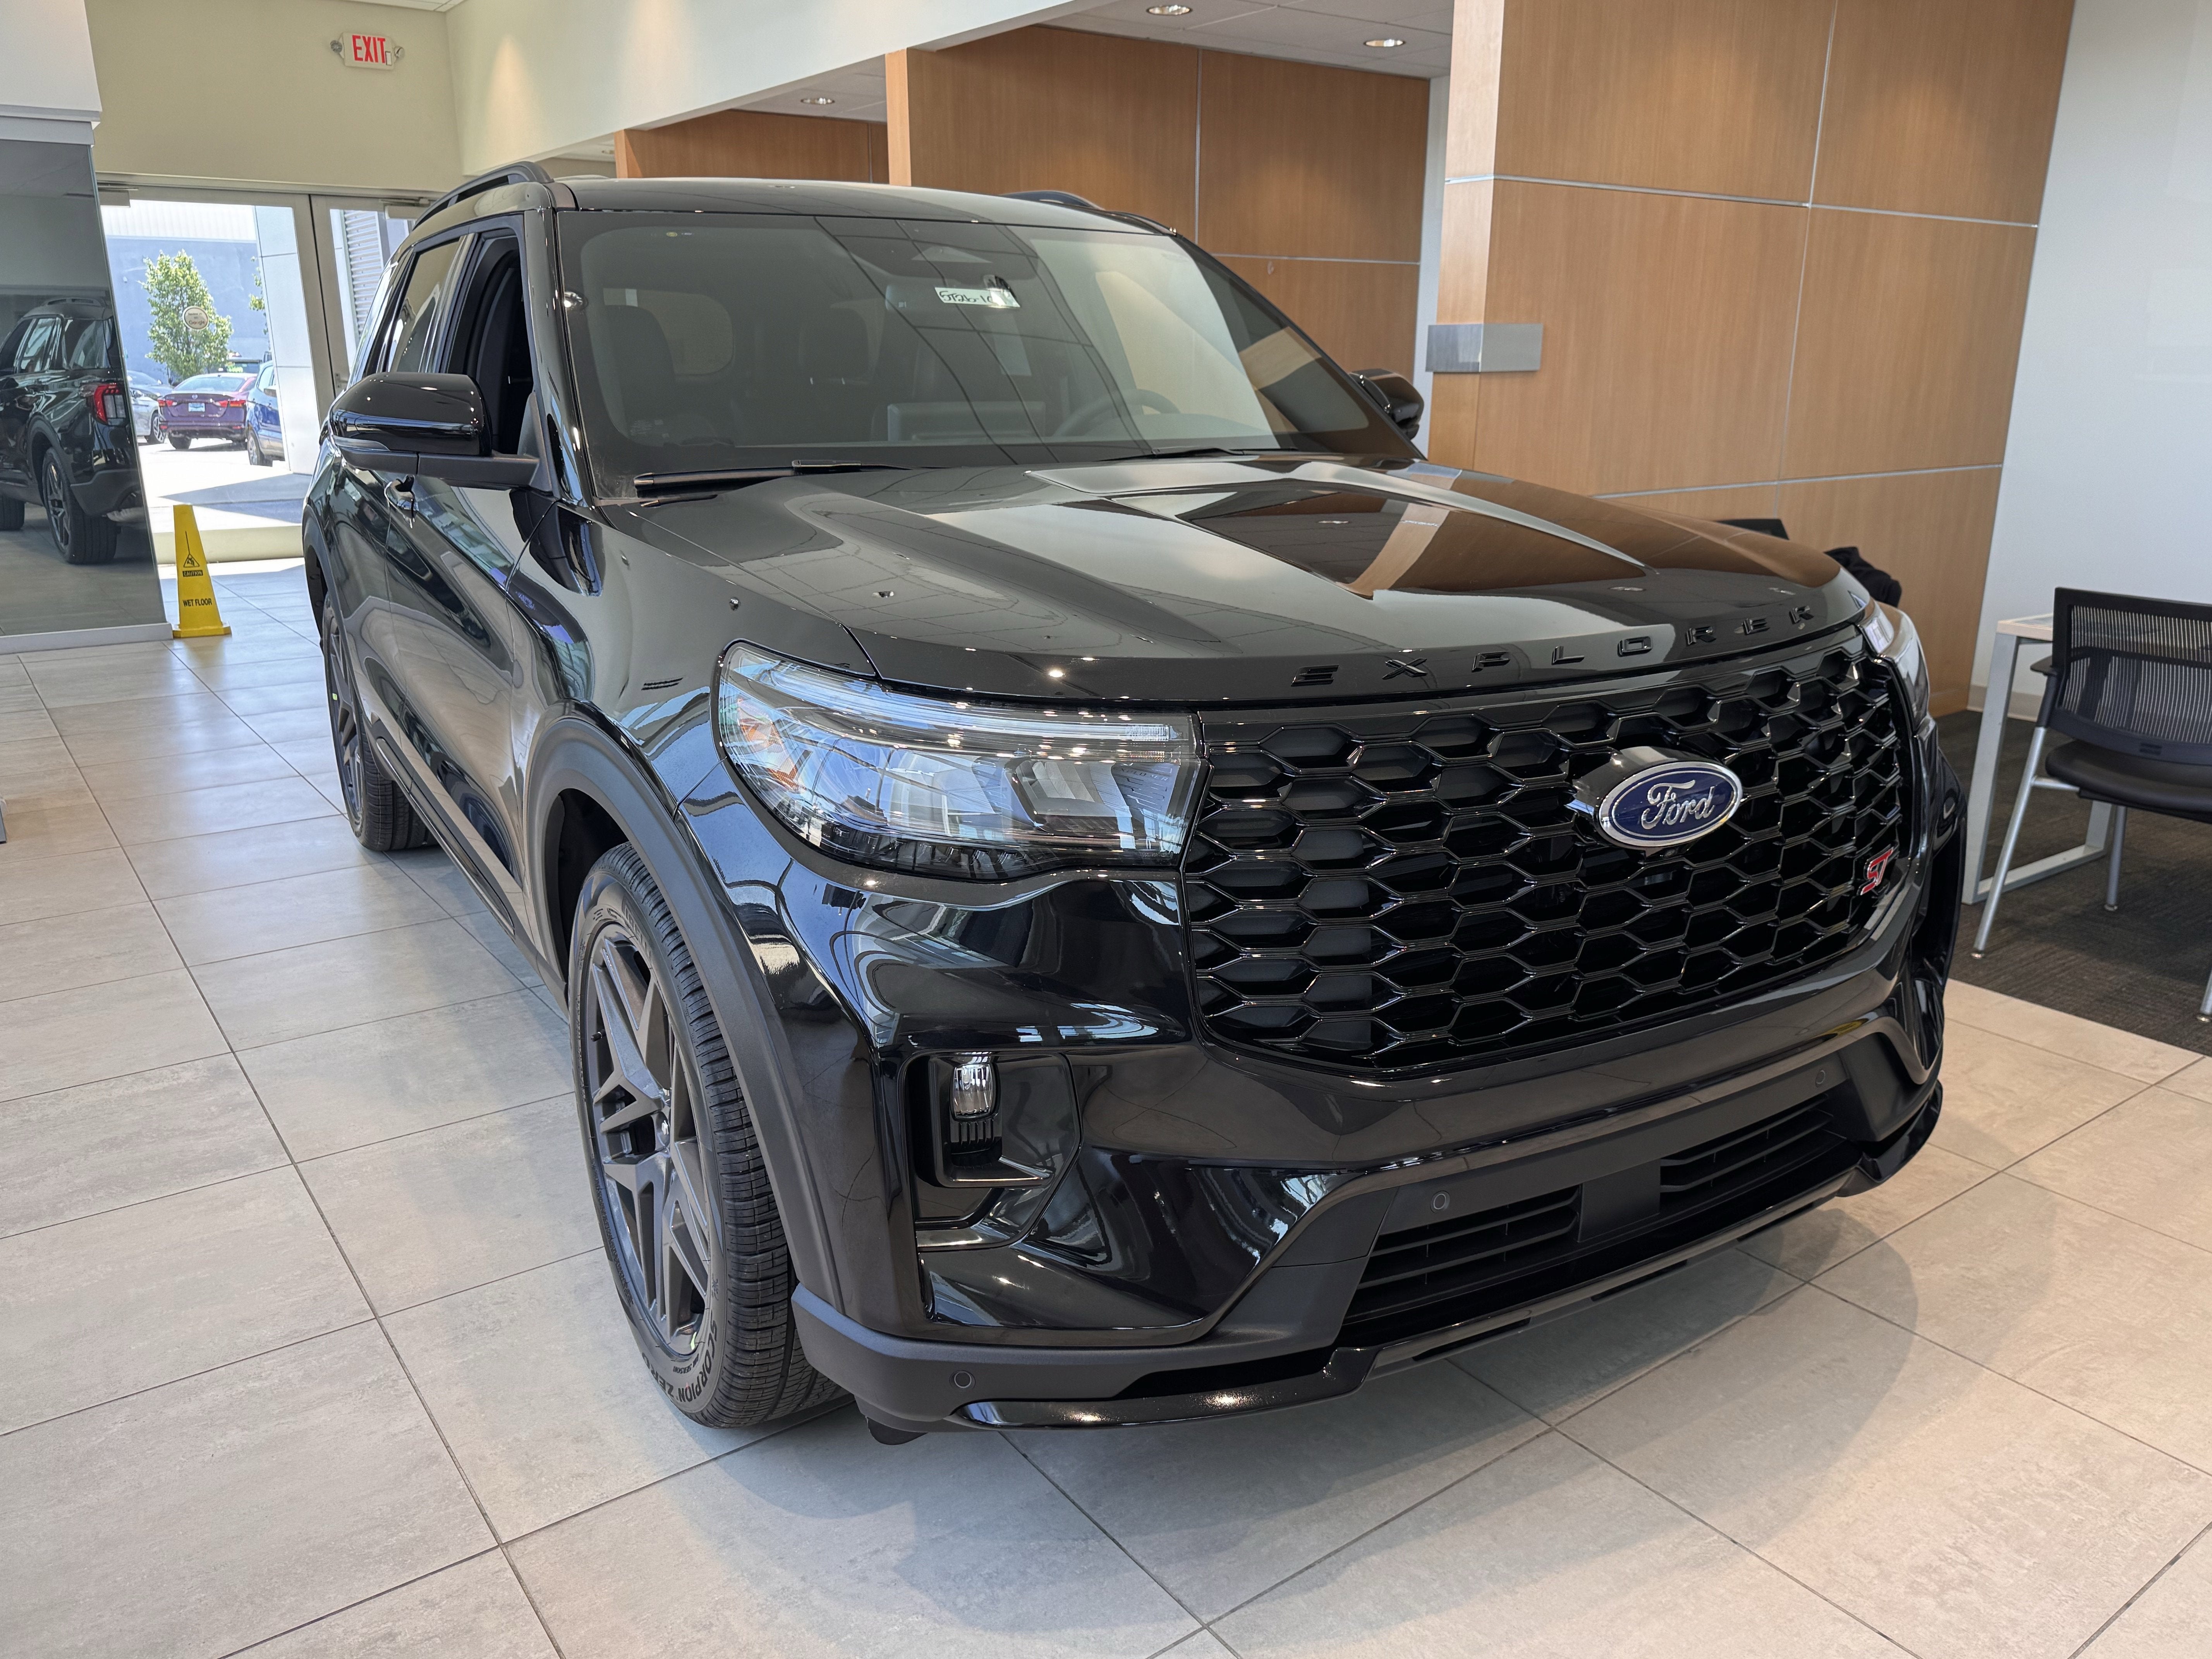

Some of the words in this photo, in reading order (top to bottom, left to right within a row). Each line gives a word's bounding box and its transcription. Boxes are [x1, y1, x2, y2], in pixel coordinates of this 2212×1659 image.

[352, 35, 386, 63] EXIT
[1291, 605, 1815, 687] EXPLORER
[1641, 780, 1715, 830] Ford
[1860, 847, 1894, 895] ST
[641, 1352, 674, 1398] ZERO
[678, 1310, 717, 1402] SCORPION
